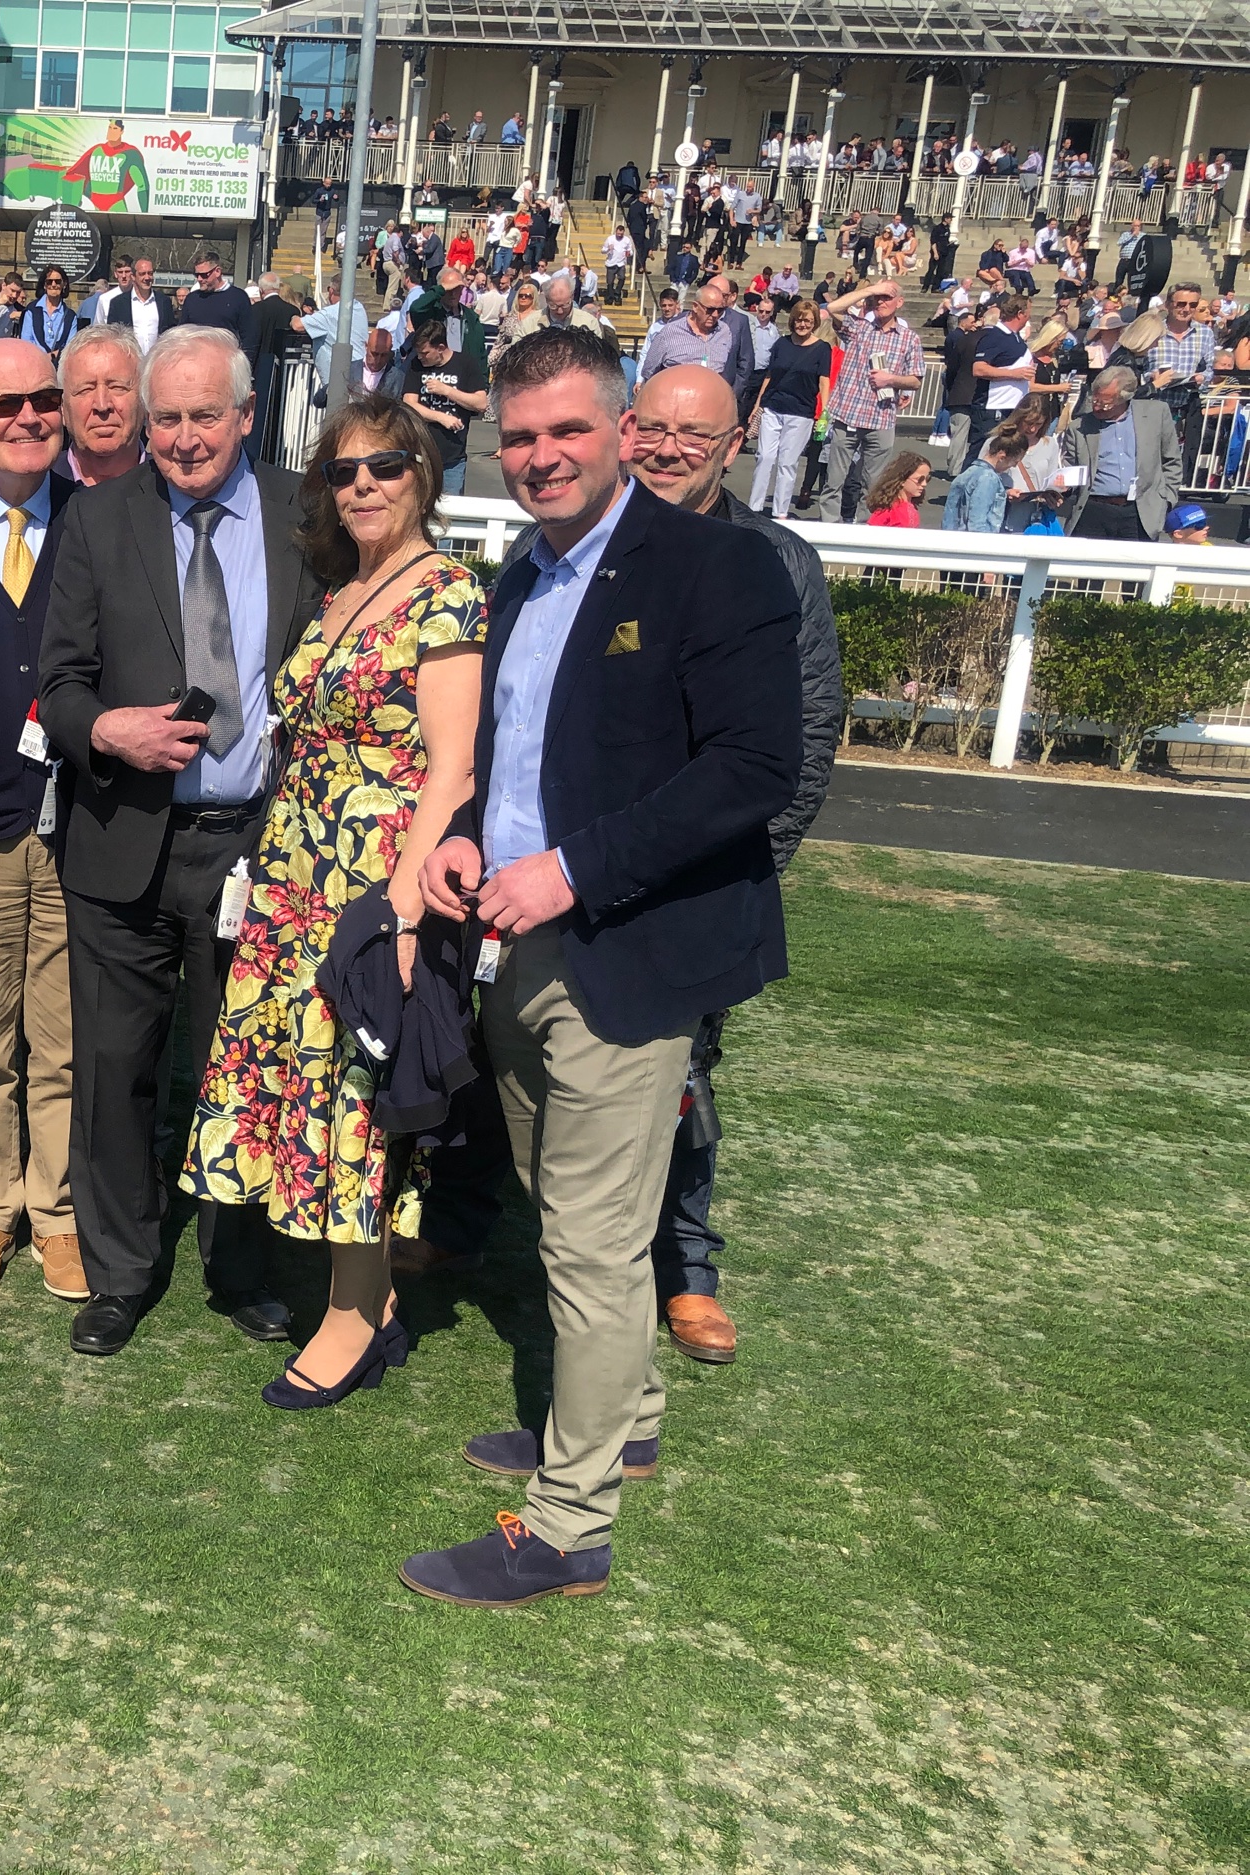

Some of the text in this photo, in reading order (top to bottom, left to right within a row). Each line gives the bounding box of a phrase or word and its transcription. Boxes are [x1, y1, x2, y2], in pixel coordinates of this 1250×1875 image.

[187, 145, 249, 162] recycle
[89, 155, 124, 174] MAX
[90, 172, 120, 183] RECYCLE
[155, 177, 248, 195] 0191 385 1333
[154, 193, 247, 209] MAXRECYCLE.COM
[34, 229, 91, 238] SAFETY NOTICE
